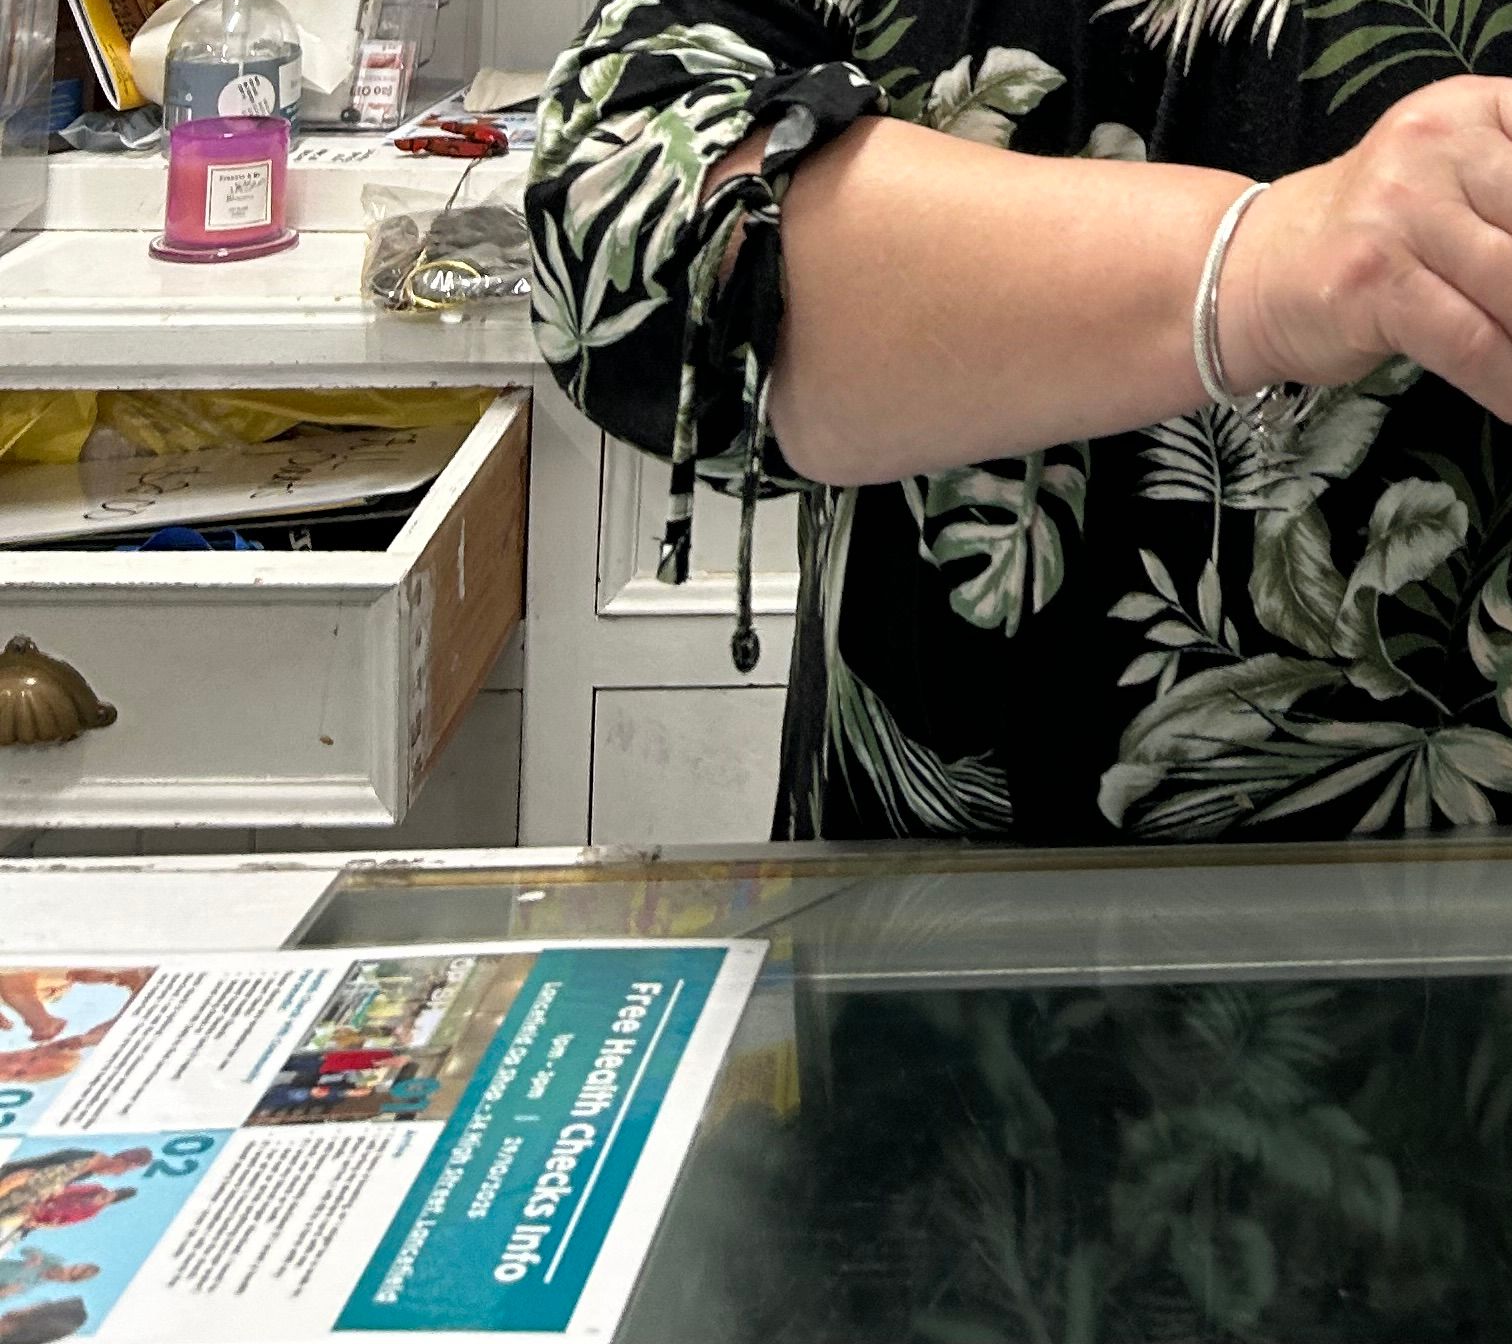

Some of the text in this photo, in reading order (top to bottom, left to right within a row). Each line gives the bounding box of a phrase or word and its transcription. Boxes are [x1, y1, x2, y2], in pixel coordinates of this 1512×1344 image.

[142, 1136, 214, 1179] 02
[493, 981, 663, 1282] Free Health Checks Info
